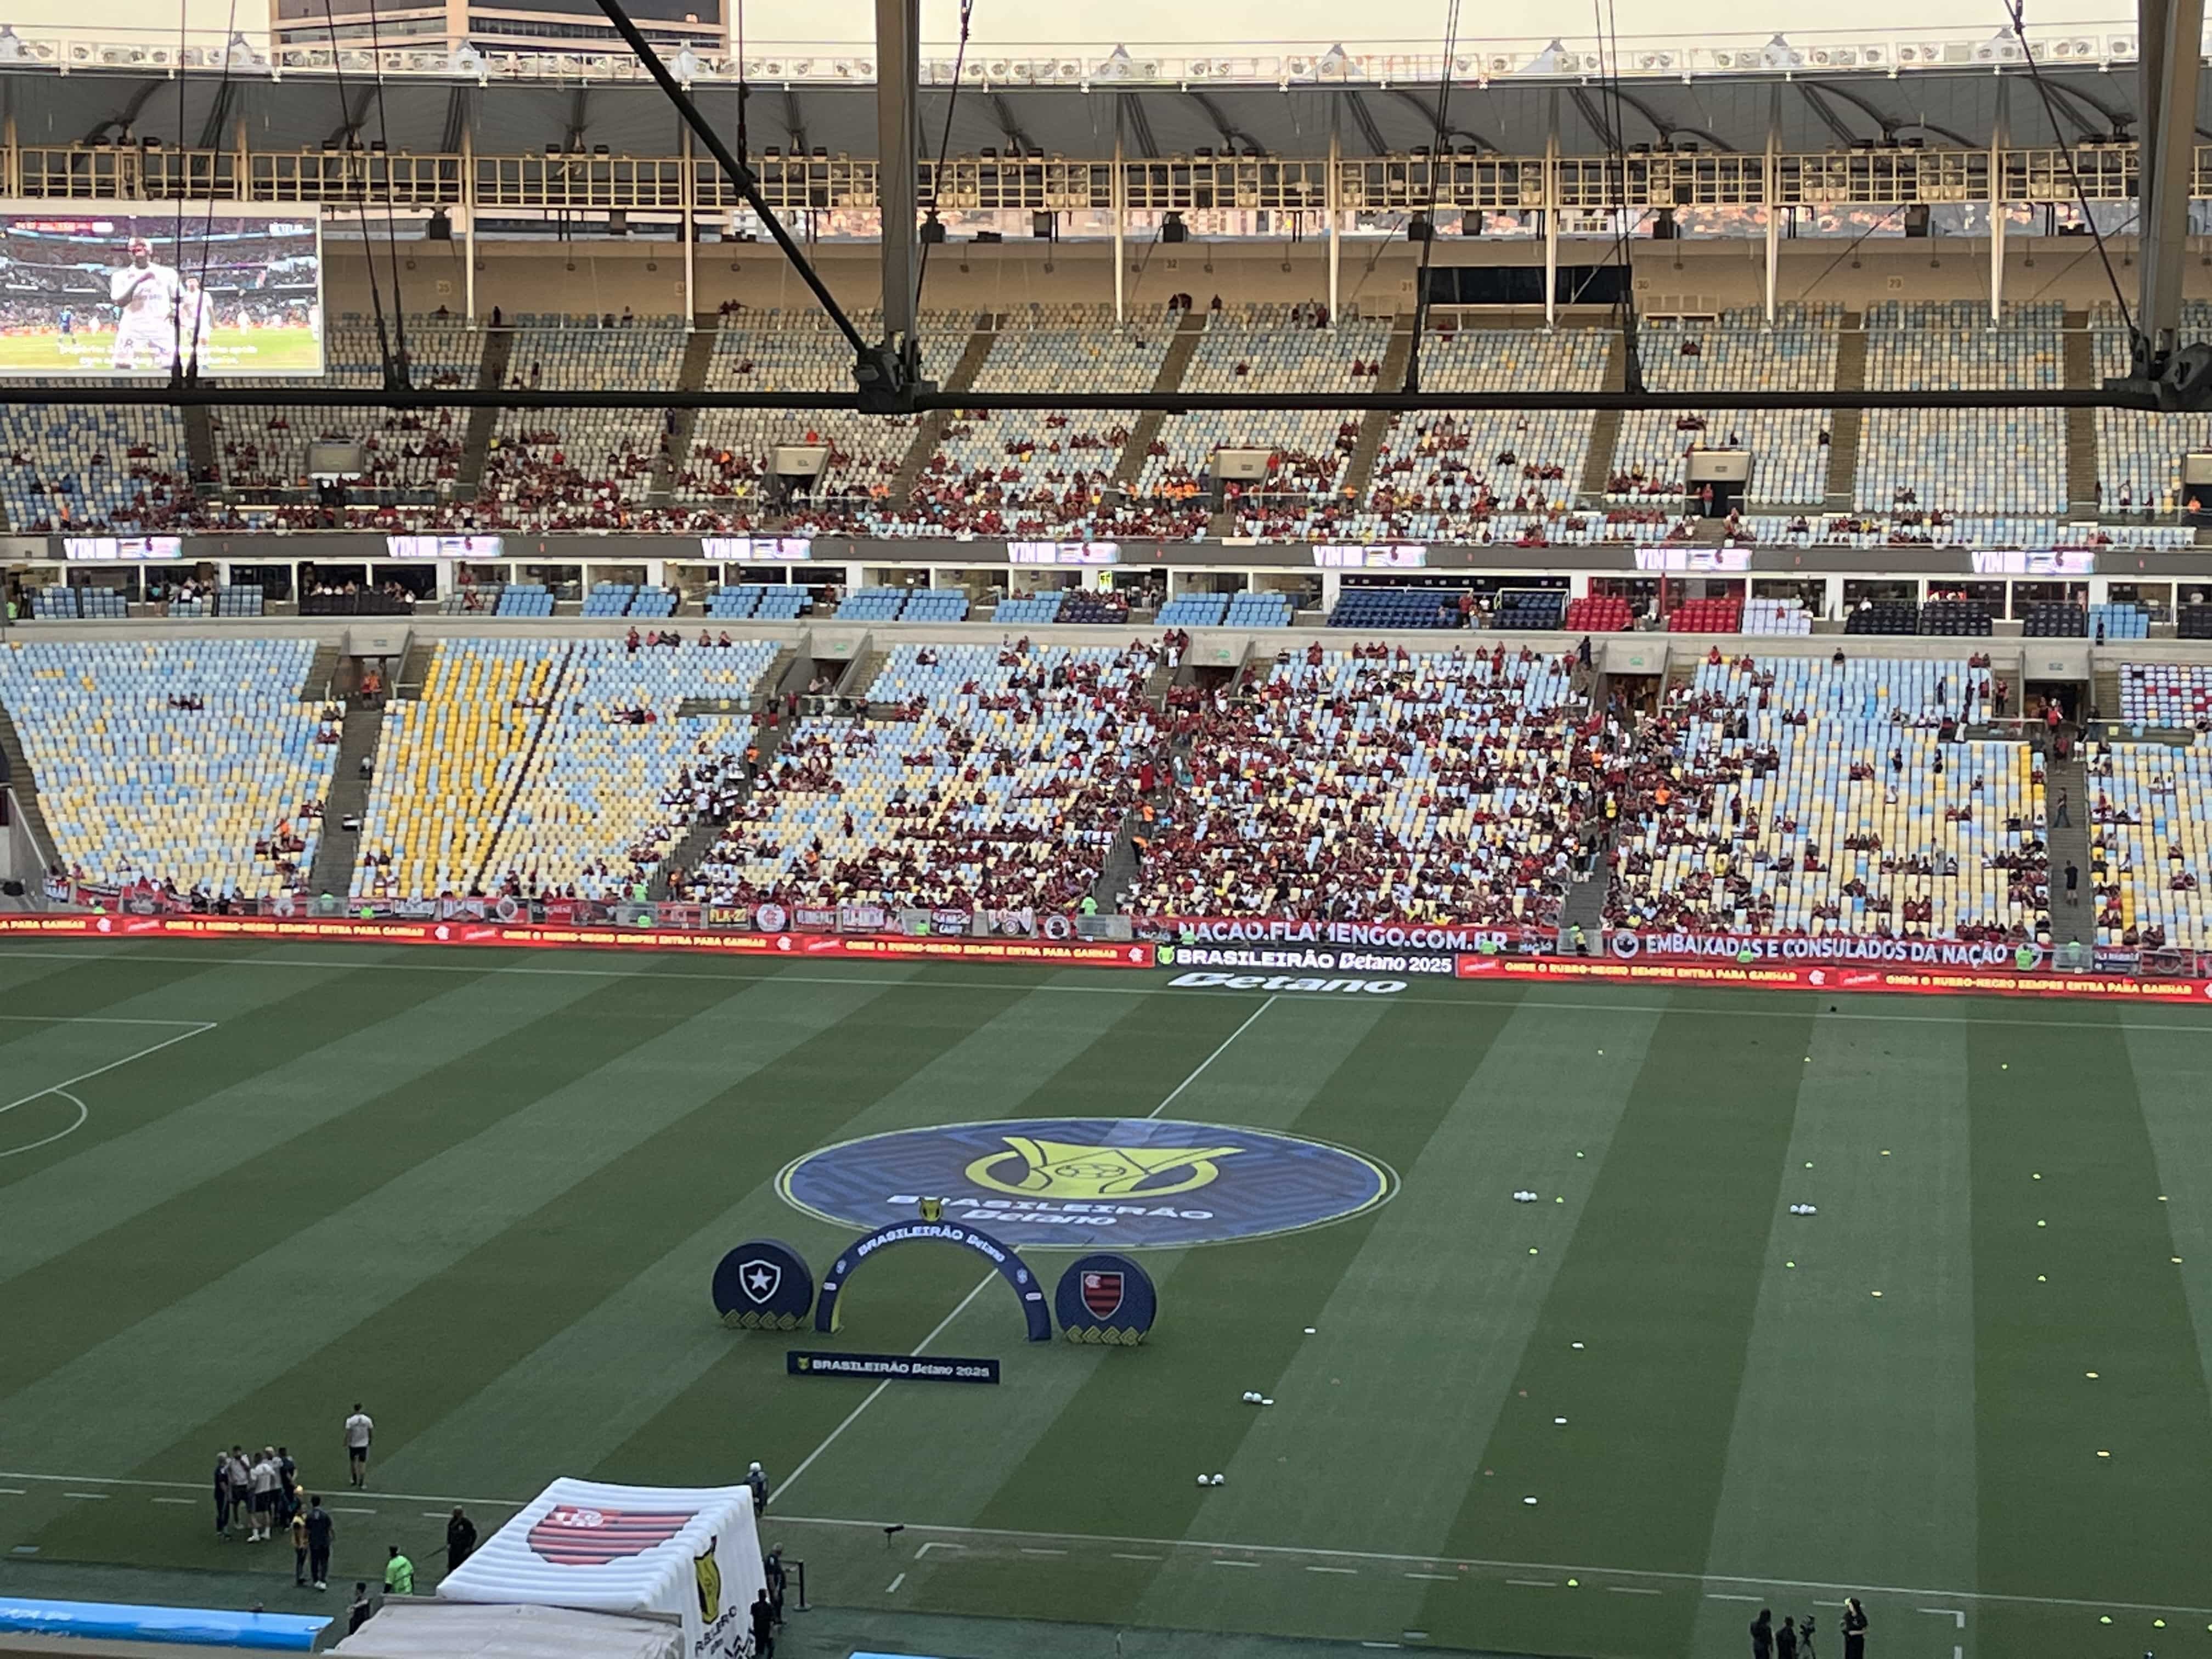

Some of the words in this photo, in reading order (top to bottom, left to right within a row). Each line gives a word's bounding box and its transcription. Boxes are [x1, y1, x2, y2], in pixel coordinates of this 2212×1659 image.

[1043, 947, 1072, 957] PARA
[1646, 933, 1763, 958] EMBAIXADAS
[1767, 939, 1779, 958] E
[1783, 938, 1906, 961] CONSULADOS
[1911, 944, 1938, 963] DA
[1942, 941, 2007, 968] NAÇÃO
[1176, 949, 1335, 968] BRASILEIRÃO
[1339, 952, 1406, 971] Betano
[1409, 957, 1452, 973] 2025
[1167, 972, 1407, 994] Betano
[1716, 969, 1747, 979] PARA
[1748, 970, 1797, 981] GANHAR
[2107, 983, 2140, 992] PARA
[2142, 984, 2192, 994] GANHAR
[961, 1209, 1118, 1227] Betano
[857, 1225, 963, 1256] BRASILEIRÃO
[966, 1234, 1006, 1262] Betano
[812, 1359, 909, 1374] BRASILEIRÃO
[912, 1363, 953, 1376] Betano
[956, 1367, 990, 1377] 2025
